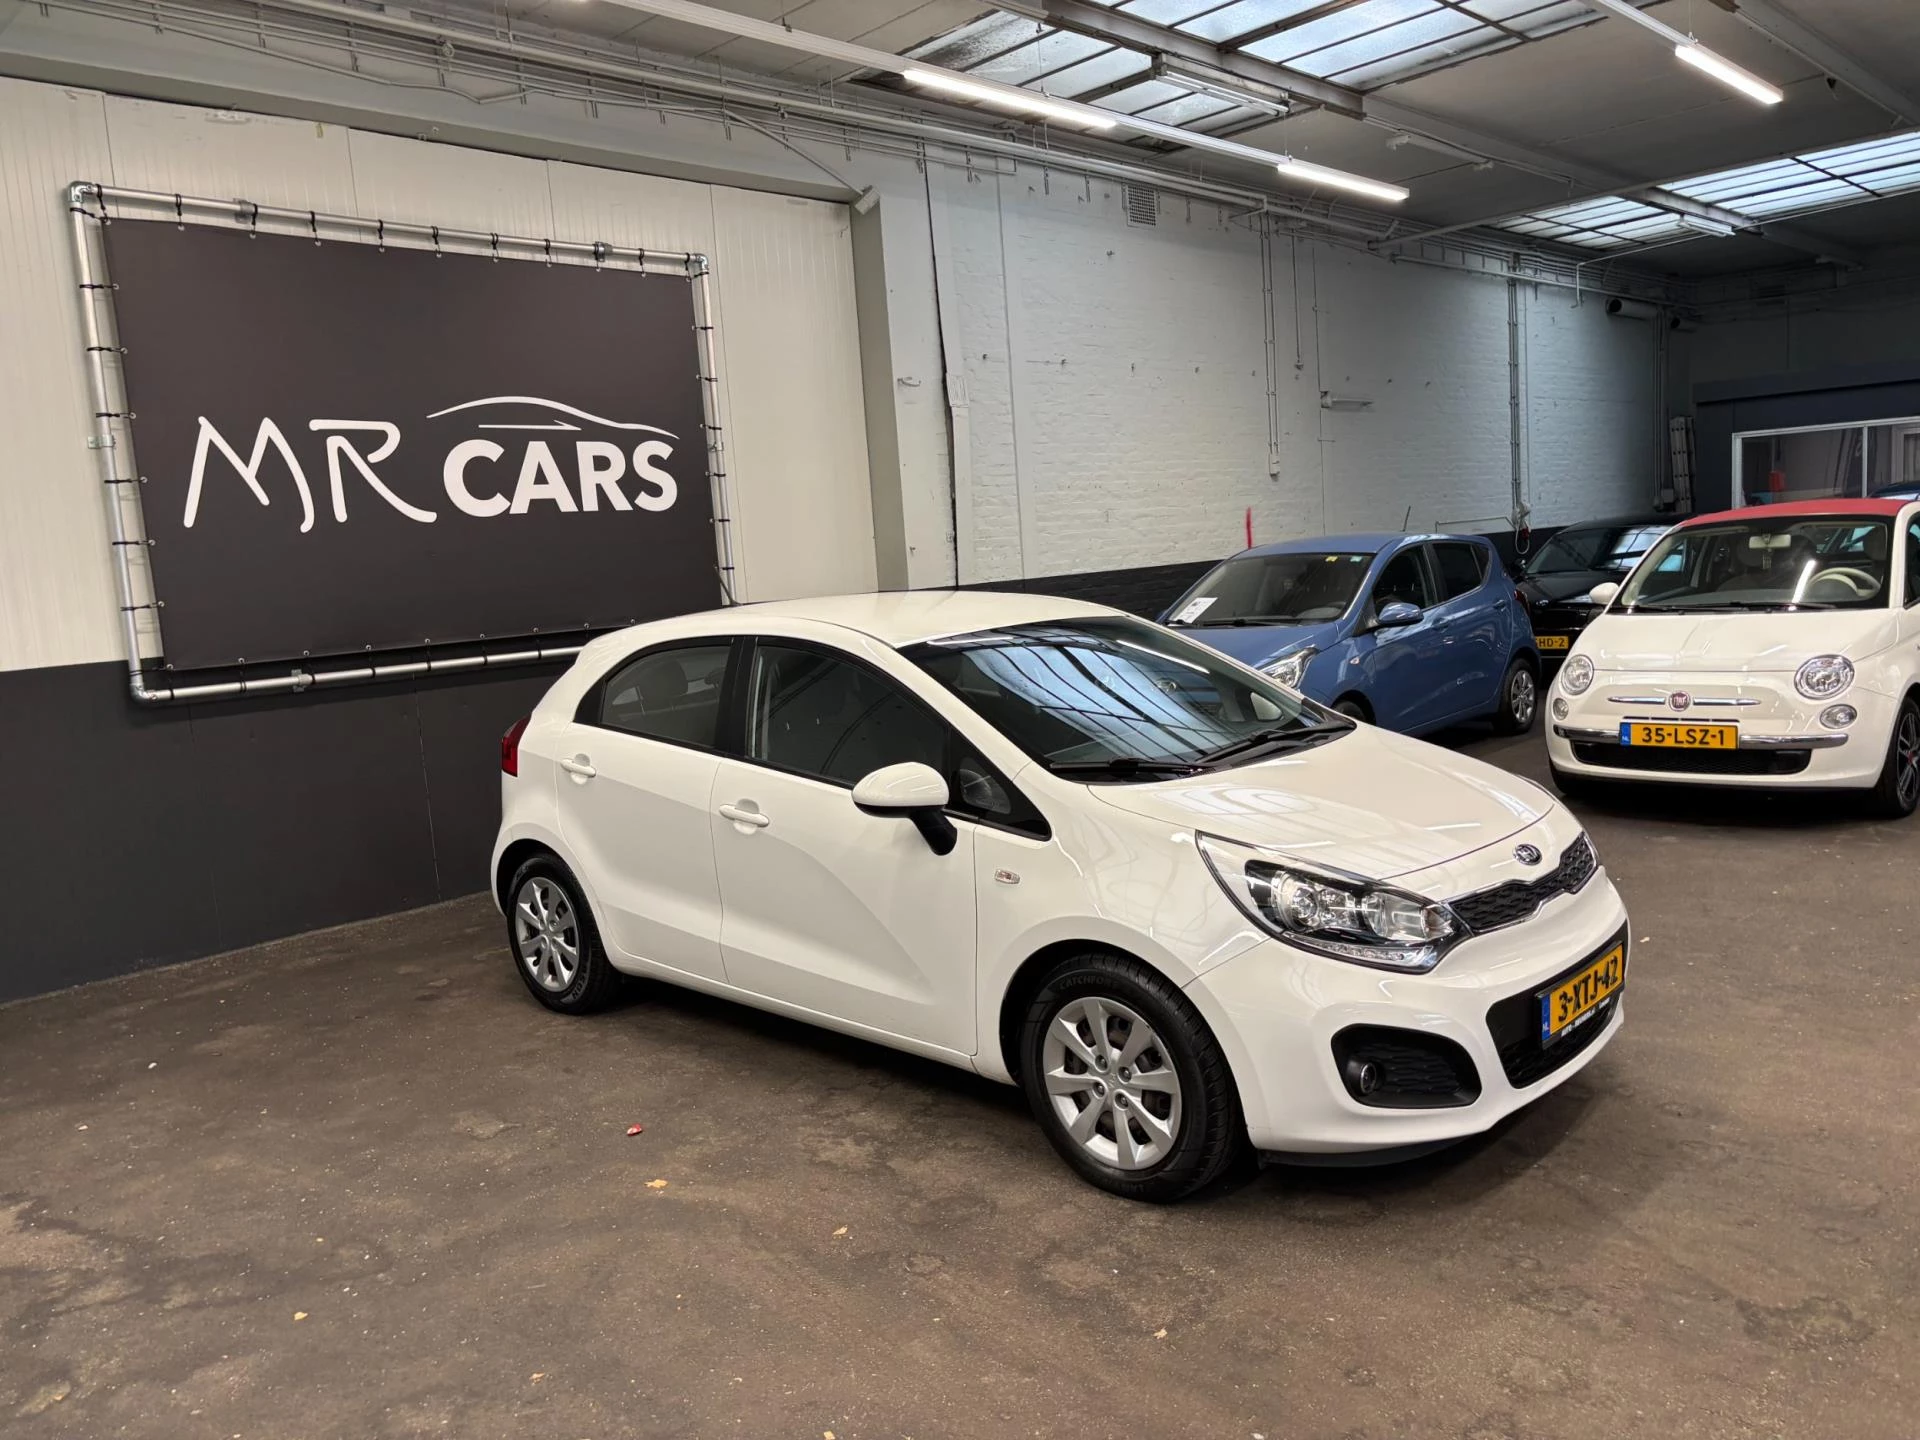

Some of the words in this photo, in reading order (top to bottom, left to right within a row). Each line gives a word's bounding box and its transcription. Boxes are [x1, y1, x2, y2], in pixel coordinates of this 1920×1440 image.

[183, 416, 437, 533] MR
[443, 438, 678, 517] CARS
[1641, 727, 1725, 746] 35-LSZ-1
[1557, 955, 1619, 1022] 3-XTJ-42
